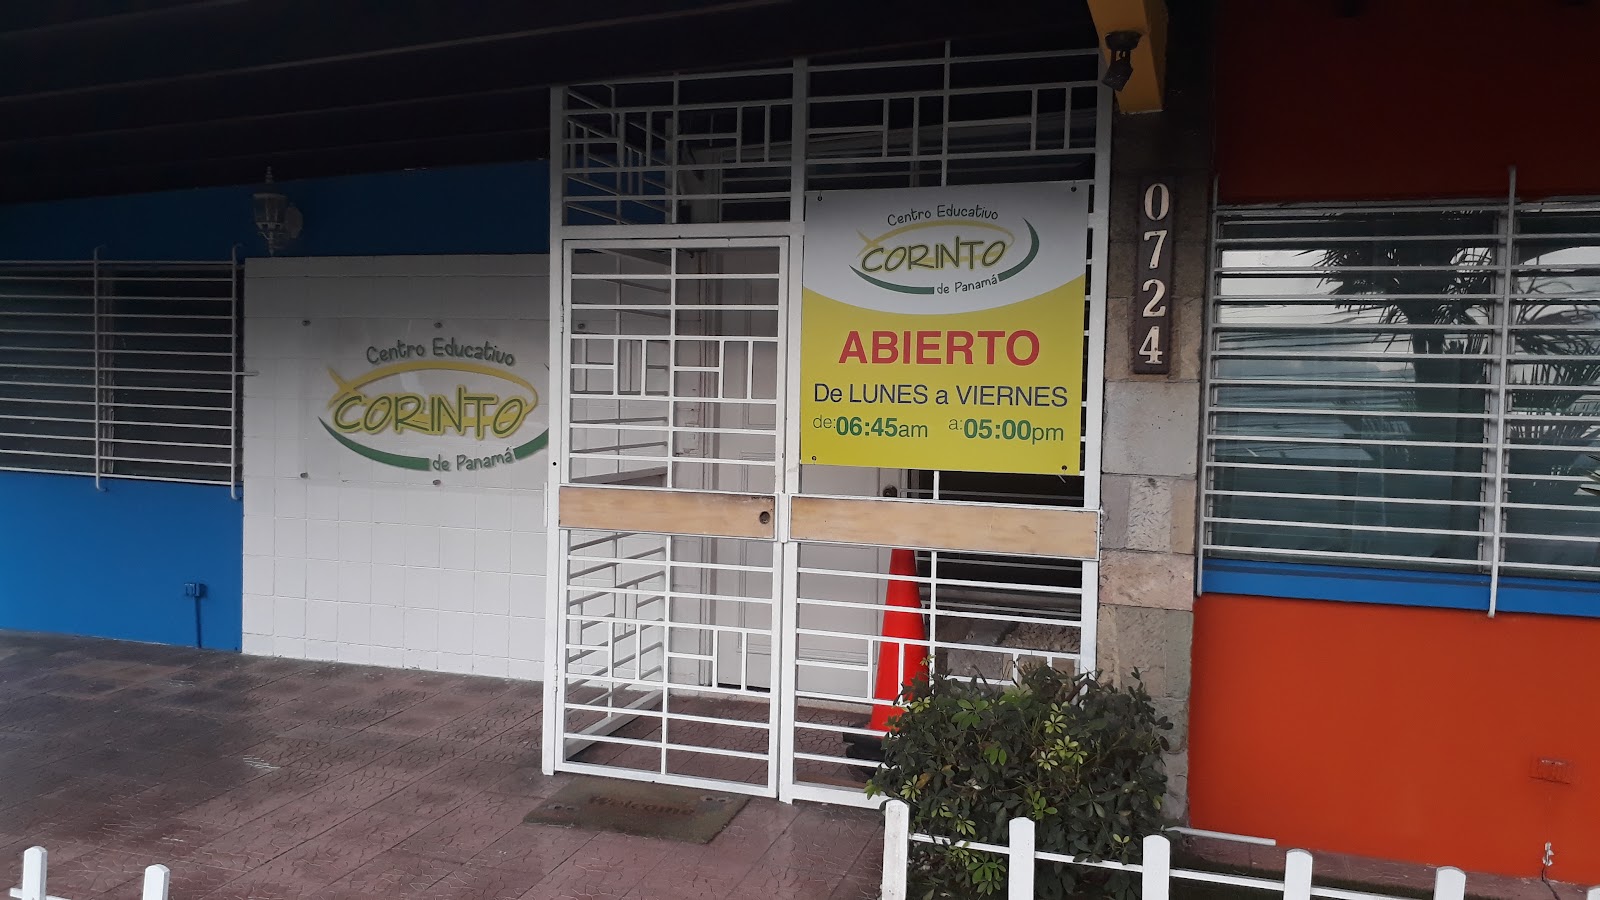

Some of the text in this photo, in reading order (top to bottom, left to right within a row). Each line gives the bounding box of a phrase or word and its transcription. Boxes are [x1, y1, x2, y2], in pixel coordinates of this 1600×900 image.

[887, 203, 999, 226] Centro Educativo
[861, 236, 1007, 273] CORINTO
[936, 274, 999, 295] de Panamá
[1138, 182, 1170, 365] 0724
[366, 336, 516, 367] Centro Educativo
[838, 329, 1040, 366] ABIERTO
[813, 383, 1069, 407] De LUNES a VIERNES
[333, 385, 526, 440] CORINTO
[432, 446, 514, 472] de Panamá
